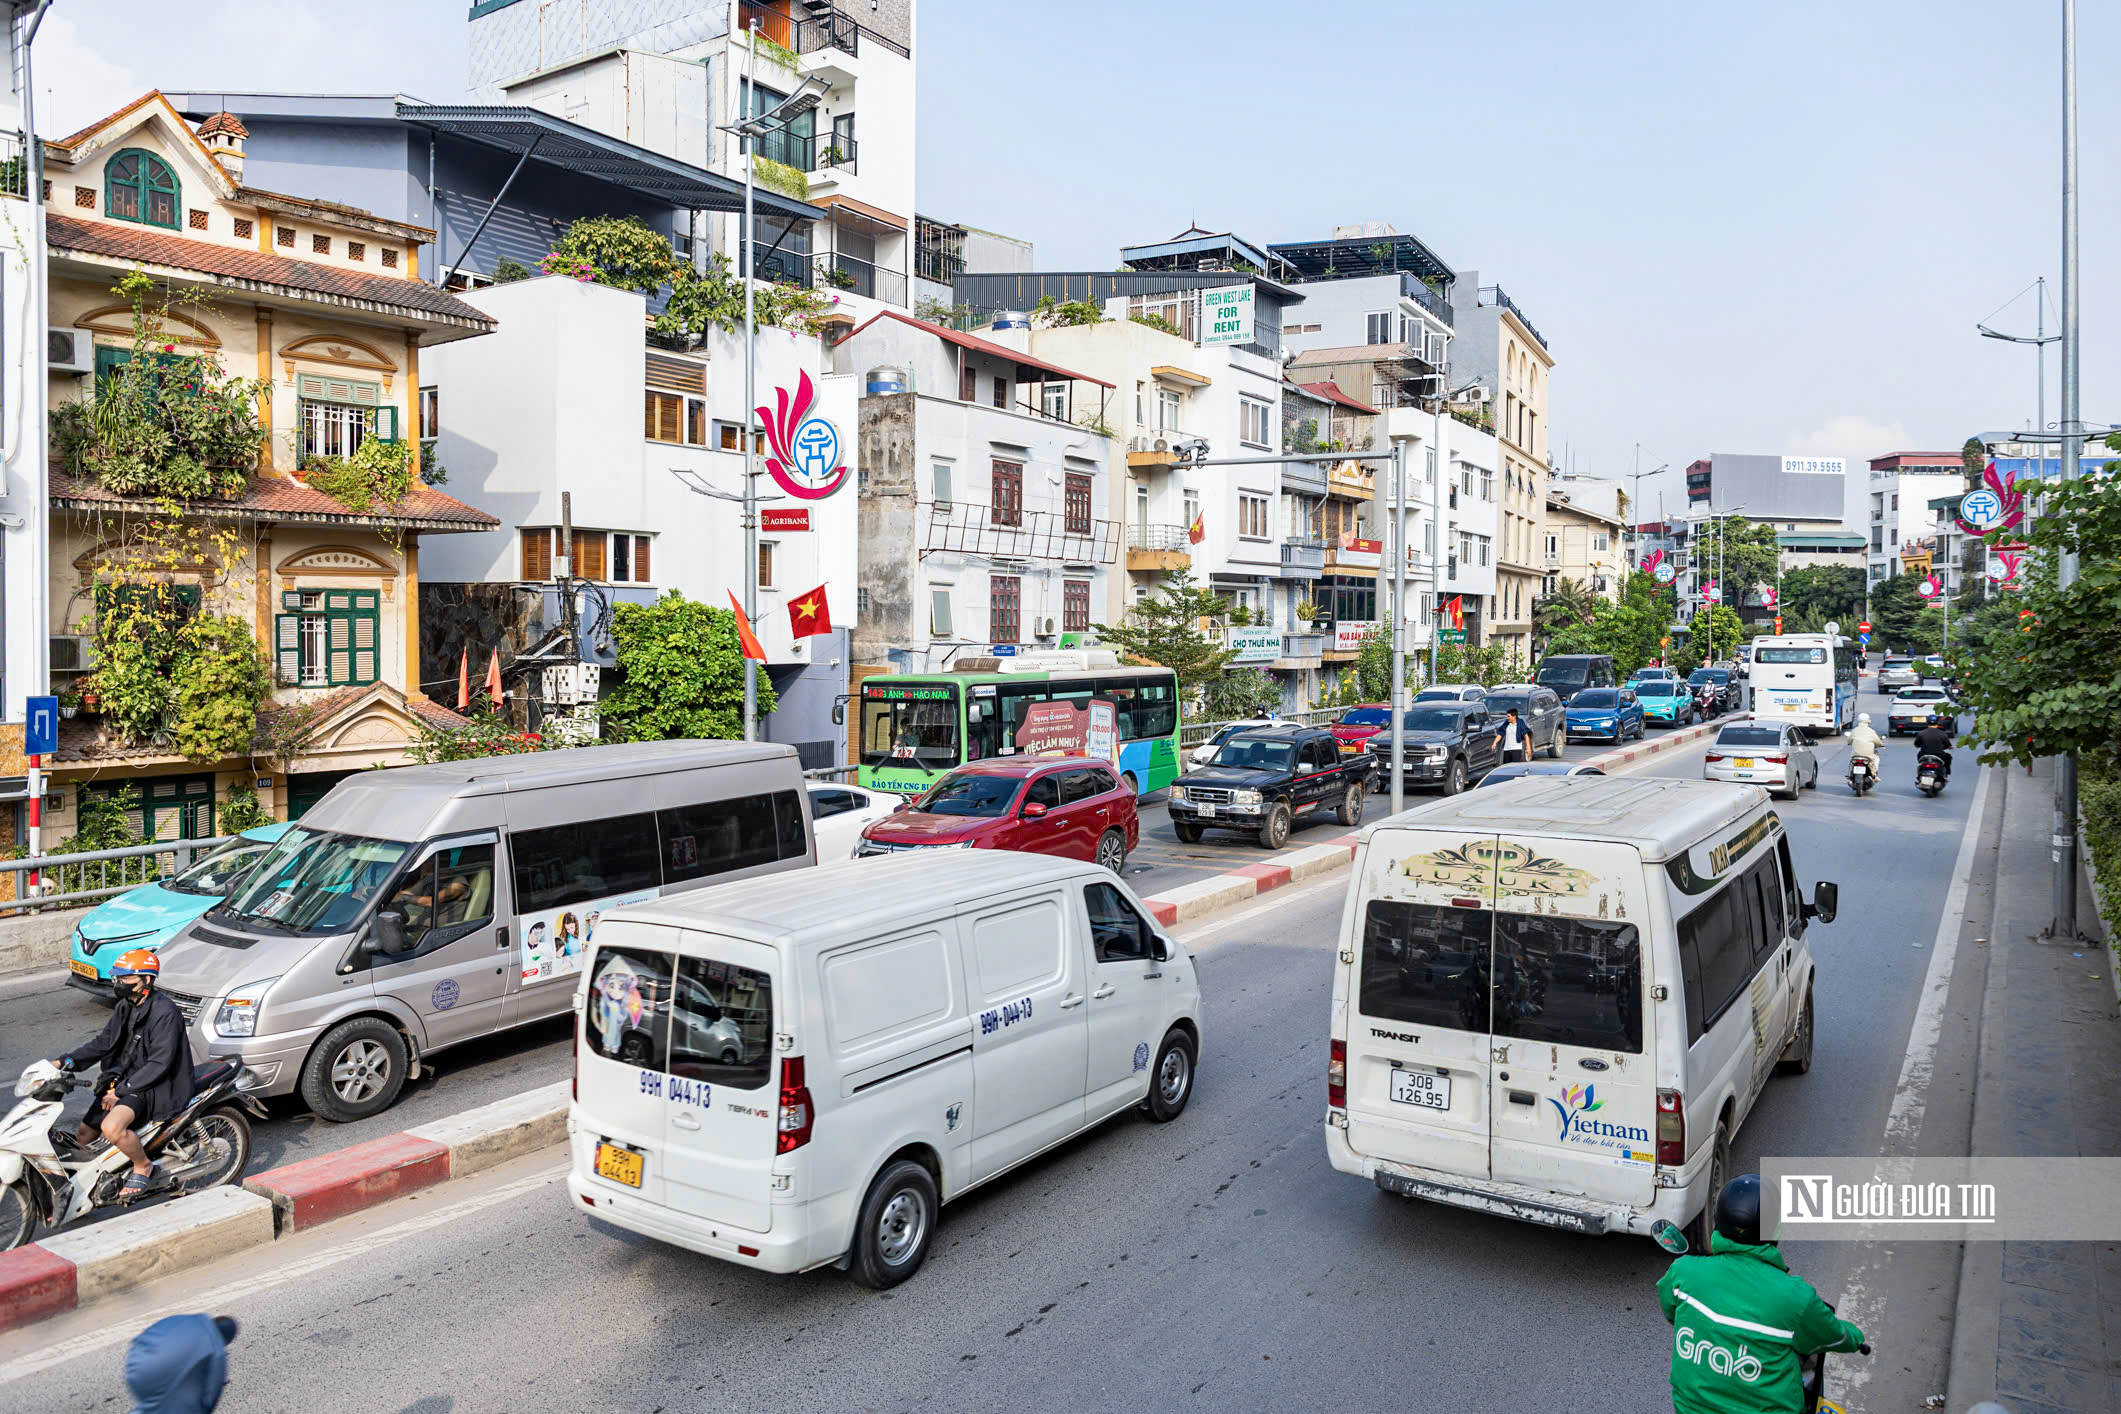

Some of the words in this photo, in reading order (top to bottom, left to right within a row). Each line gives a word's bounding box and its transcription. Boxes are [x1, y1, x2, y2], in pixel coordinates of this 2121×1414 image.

[1205, 292, 1222, 306] GREEN
[1222, 290, 1237, 304] WEST
[1238, 288, 1251, 302] LAKE
[1217, 306, 1238, 319] FOR
[1214, 320, 1241, 333] RENT
[1785, 460, 1843, 473] 0911.39.5555
[770, 517, 809, 525] AGRIBANK
[1232, 639, 1247, 649] CHO
[1248, 636, 1265, 648] THUÊ
[1266, 636, 1281, 648] NHÀ
[867, 688, 883, 698] 143
[888, 690, 905, 699] ANH
[932, 690, 950, 699] NAM
[1041, 735, 1057, 750] LÀM
[259, 778, 272, 787] 109
[903, 782, 920, 791] CNG
[1477, 849, 1520, 862] VIP
[1369, 1028, 1421, 1045] TRANSIT
[1408, 1073, 1433, 1090] 30B
[640, 1070, 662, 1098] 99H
[668, 1077, 711, 1109] 044.13
[1398, 1087, 1443, 1107] 126.95
[1546, 1097, 1650, 1143] Vietnam
[612, 1148, 630, 1166] 99H
[1676, 1326, 1763, 1383] Grab
